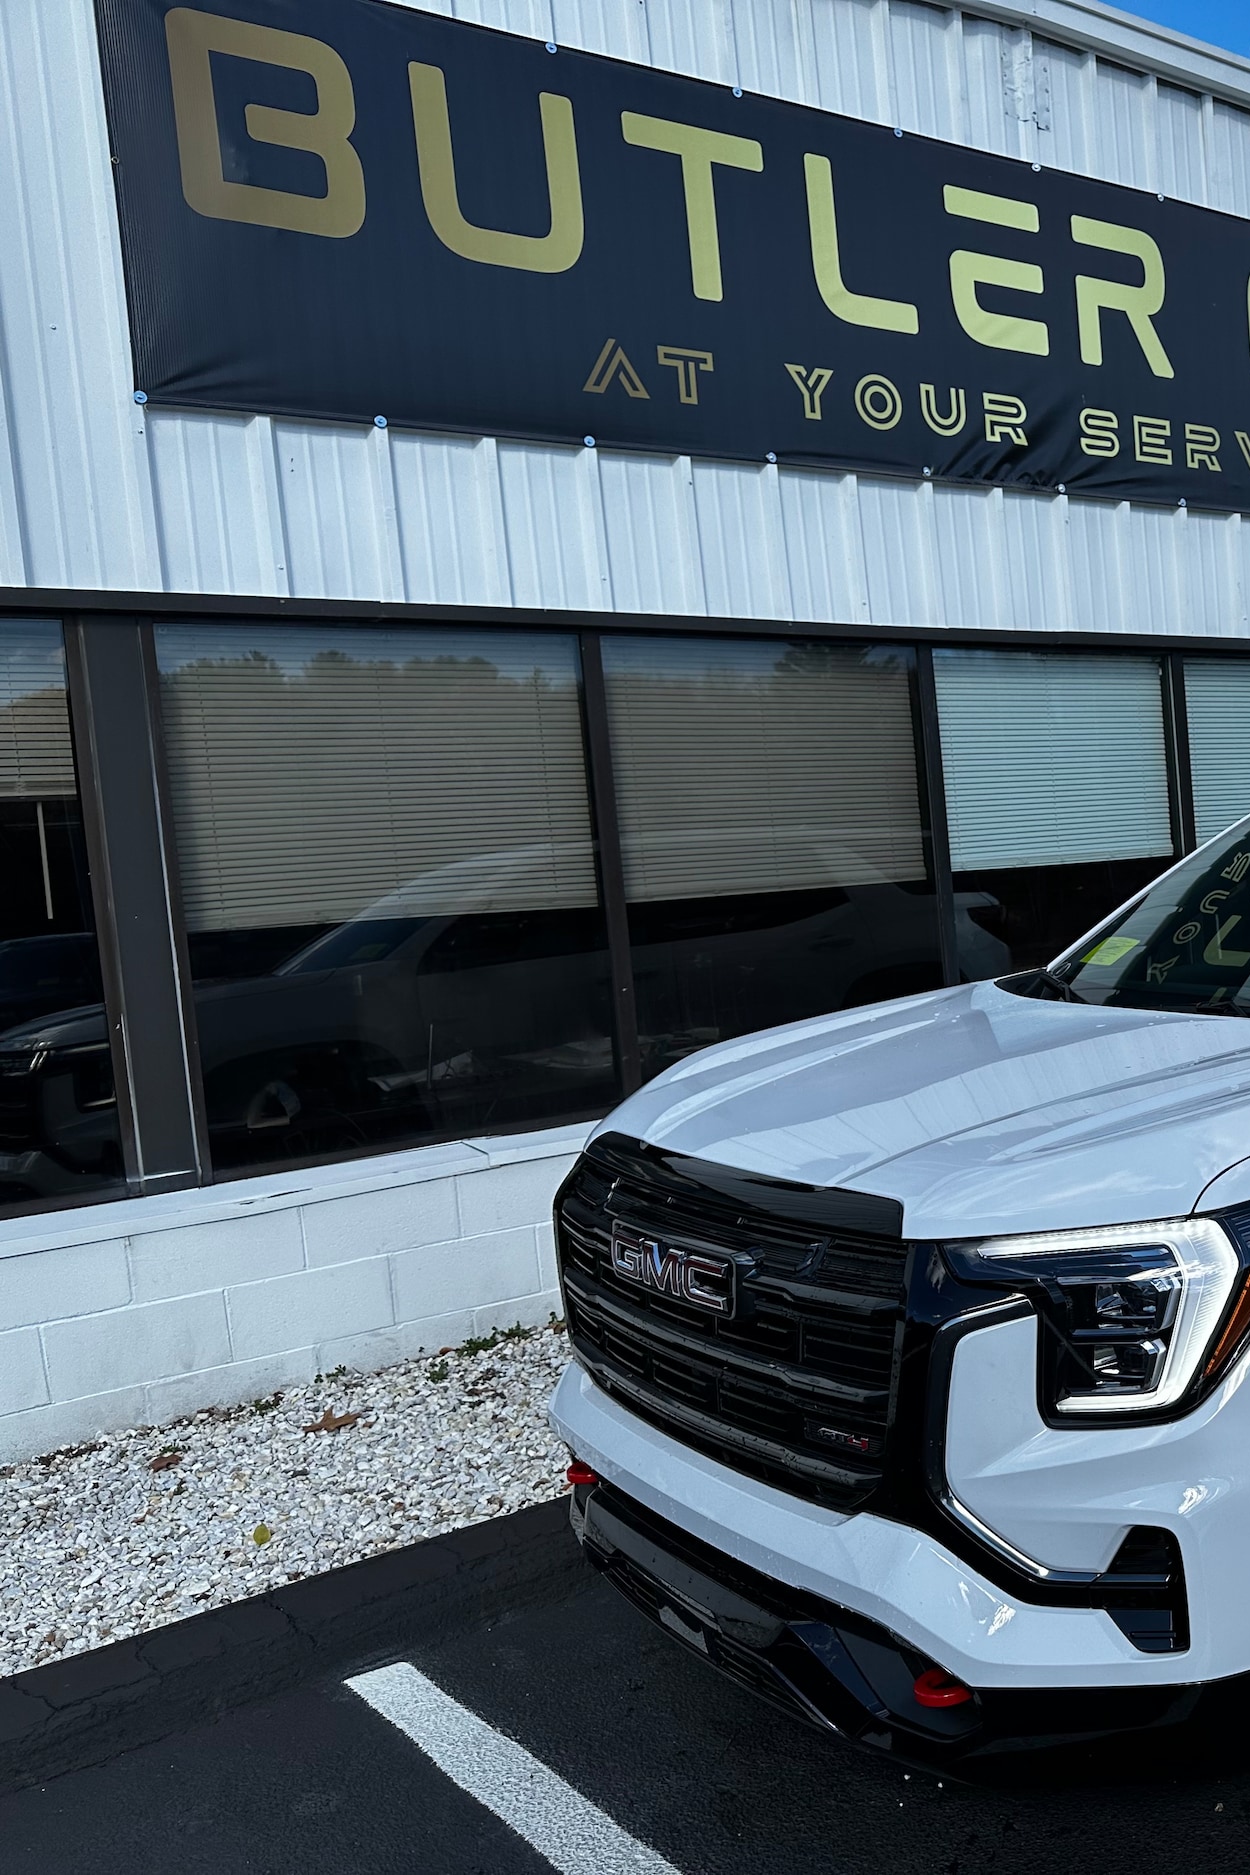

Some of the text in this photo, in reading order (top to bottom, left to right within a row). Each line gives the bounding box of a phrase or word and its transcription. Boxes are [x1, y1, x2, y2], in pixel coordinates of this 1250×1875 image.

[165, 7, 1175, 379] BUTLER
[583, 338, 714, 405] AT
[784, 362, 1029, 447] YOUR
[612, 1229, 729, 1311] GMC
